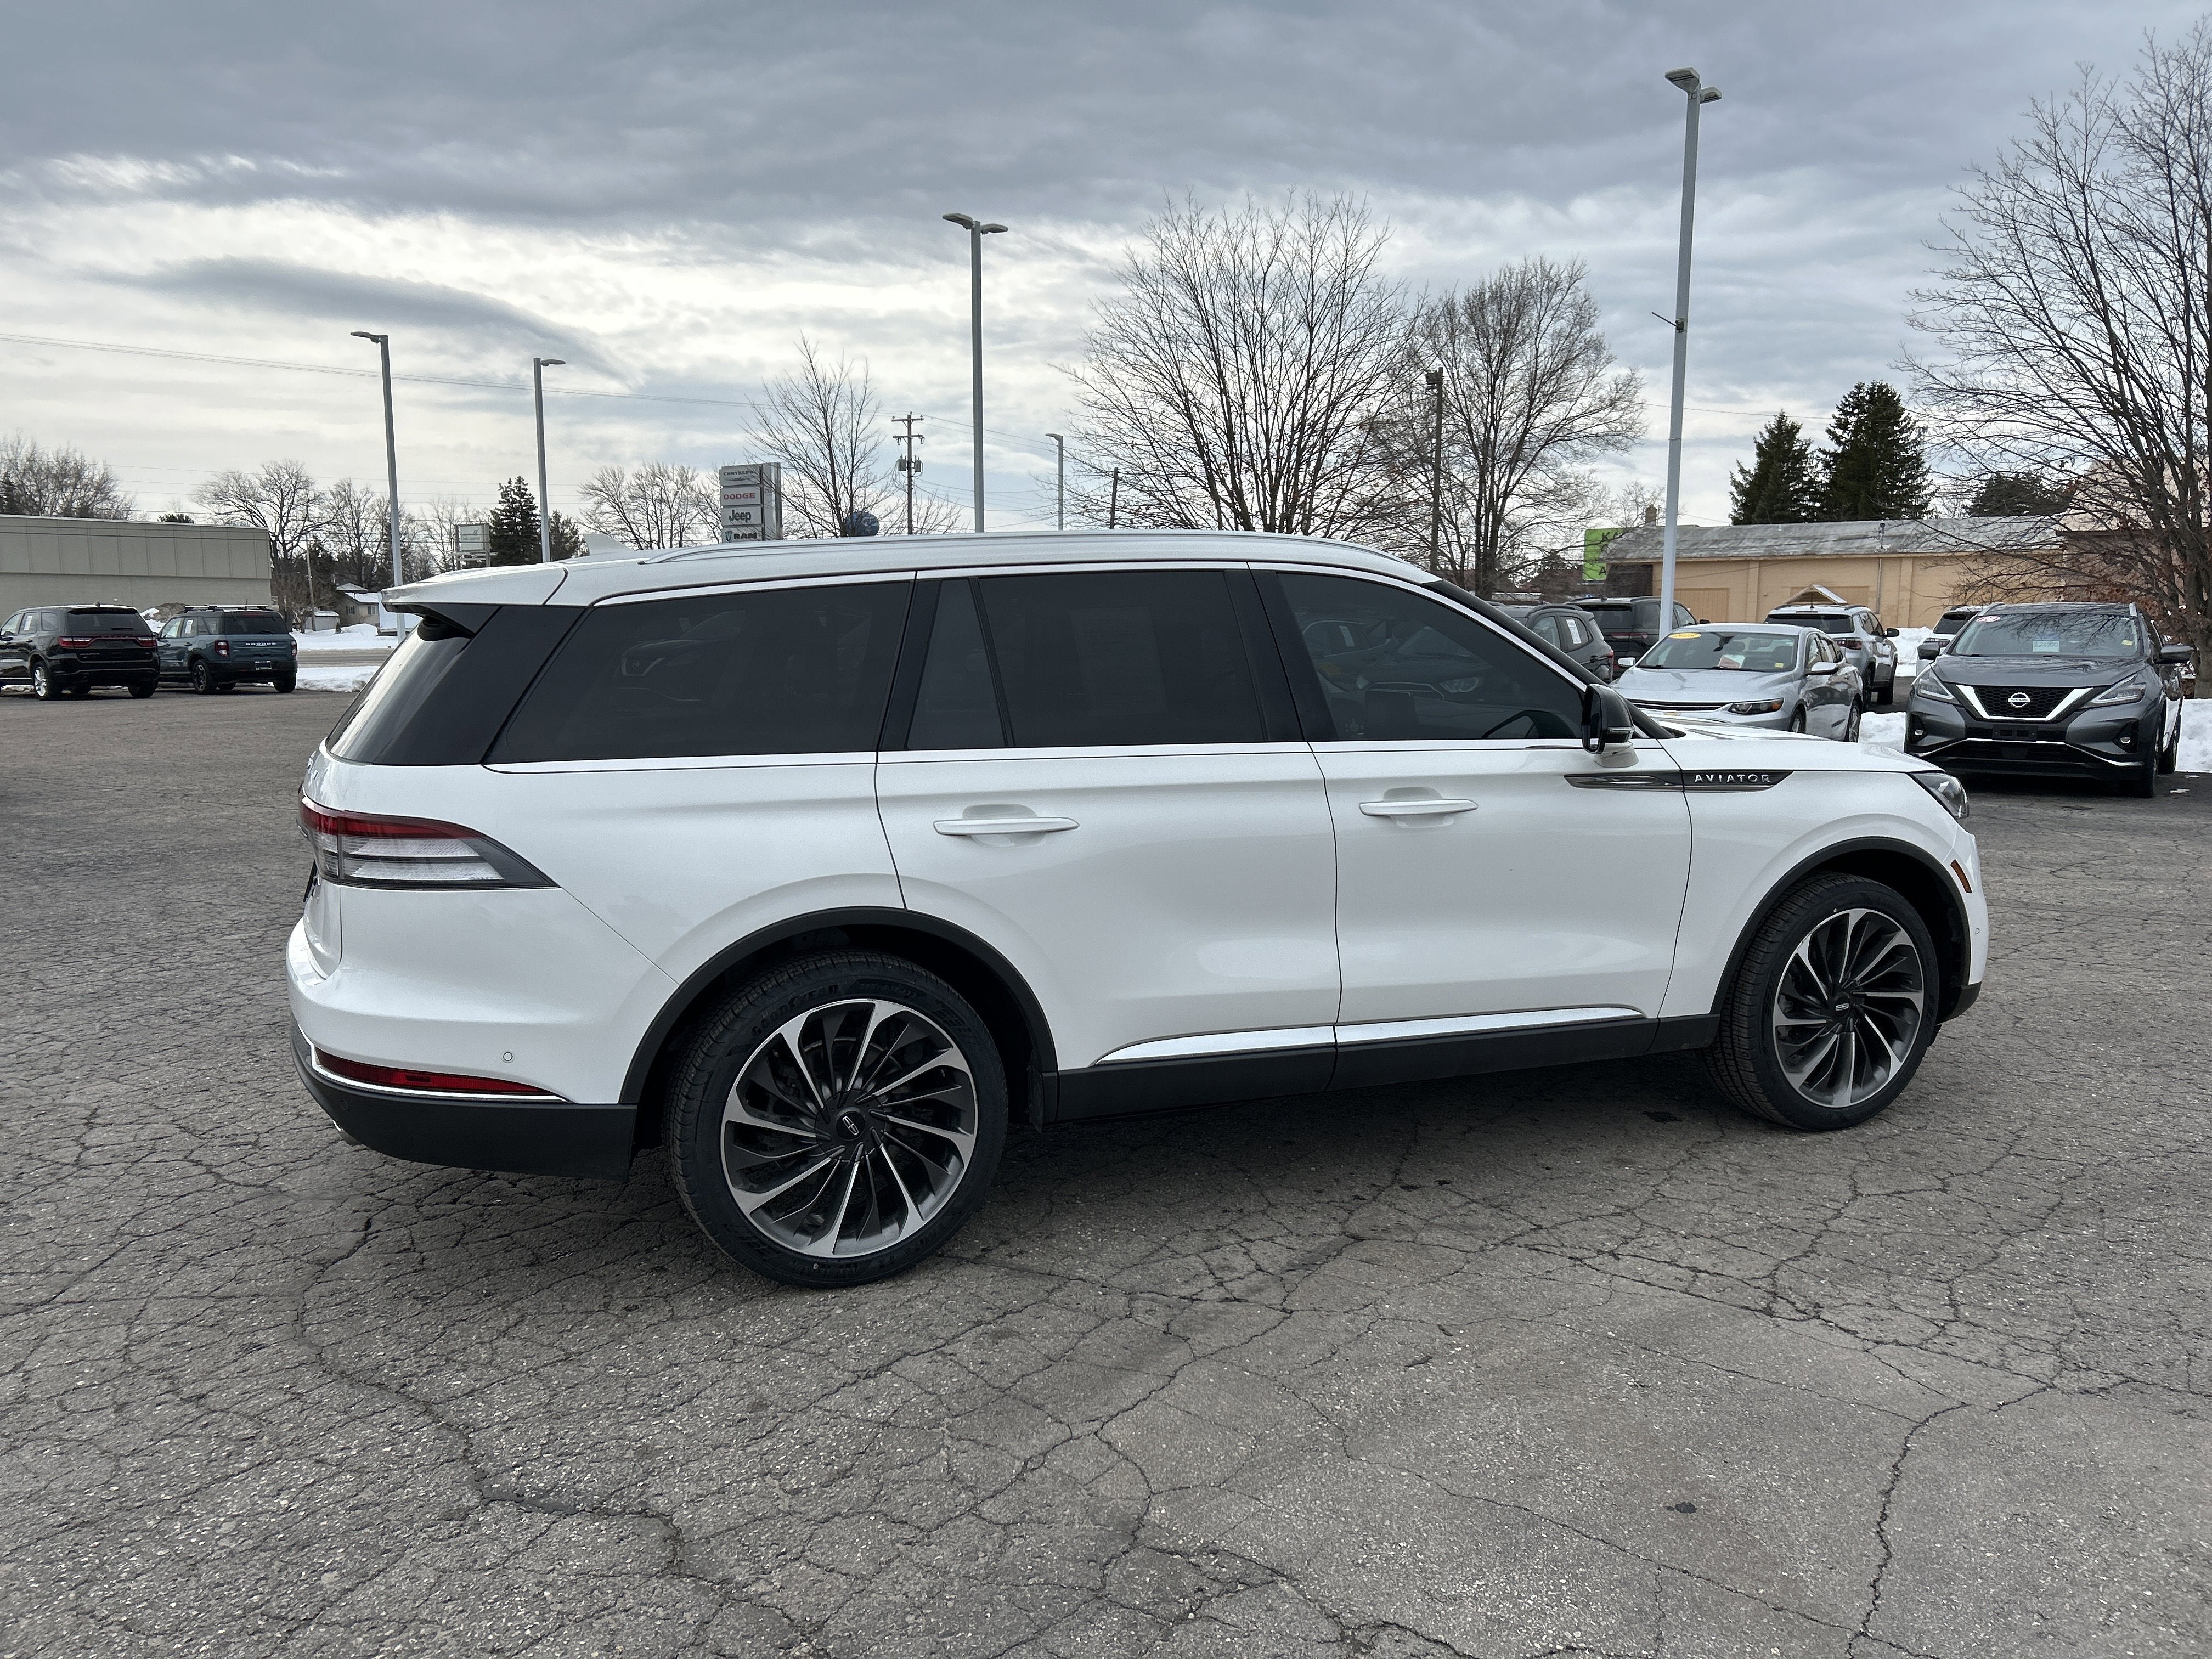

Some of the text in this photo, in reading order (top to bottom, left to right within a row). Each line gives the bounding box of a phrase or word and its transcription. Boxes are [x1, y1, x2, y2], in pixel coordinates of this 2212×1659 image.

[728, 510, 752, 523] Jeep
[1694, 774, 1770, 783] AVIATOR
[751, 984, 839, 1037] GOODYEAR
